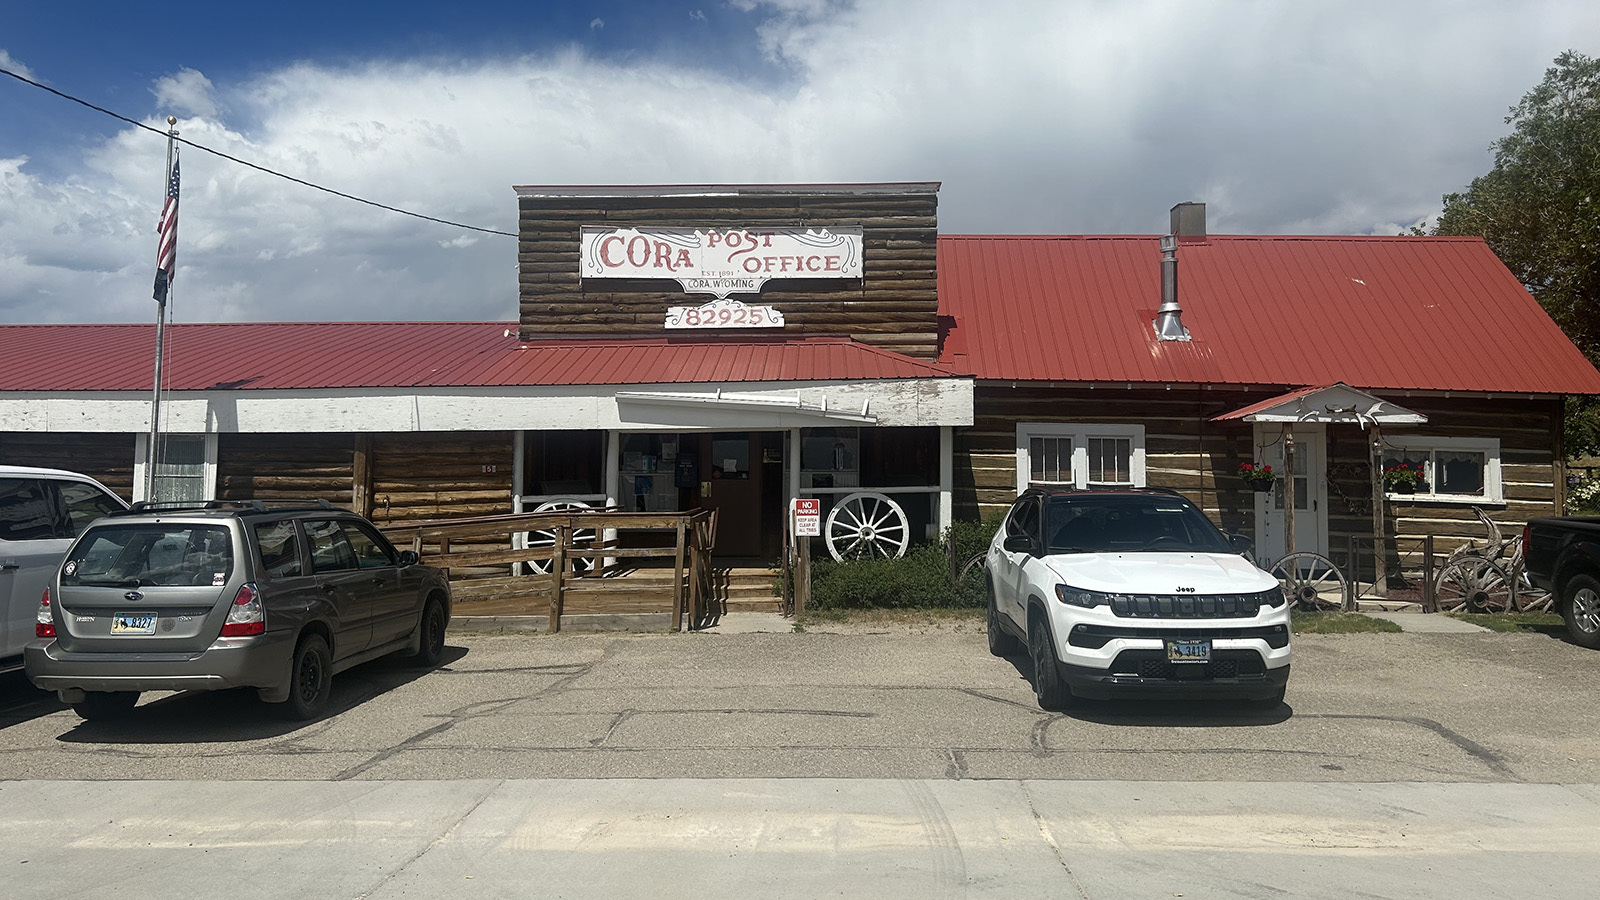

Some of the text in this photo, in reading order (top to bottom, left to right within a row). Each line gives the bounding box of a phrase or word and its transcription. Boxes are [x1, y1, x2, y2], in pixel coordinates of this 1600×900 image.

[600, 232, 775, 272] CORA POST
[742, 255, 841, 273] OFFICE
[713, 278, 754, 289] WYOMING
[685, 309, 764, 326] 82925
[802, 501, 813, 509] NO
[131, 617, 153, 629] 8327
[1185, 646, 1207, 657] 3419
